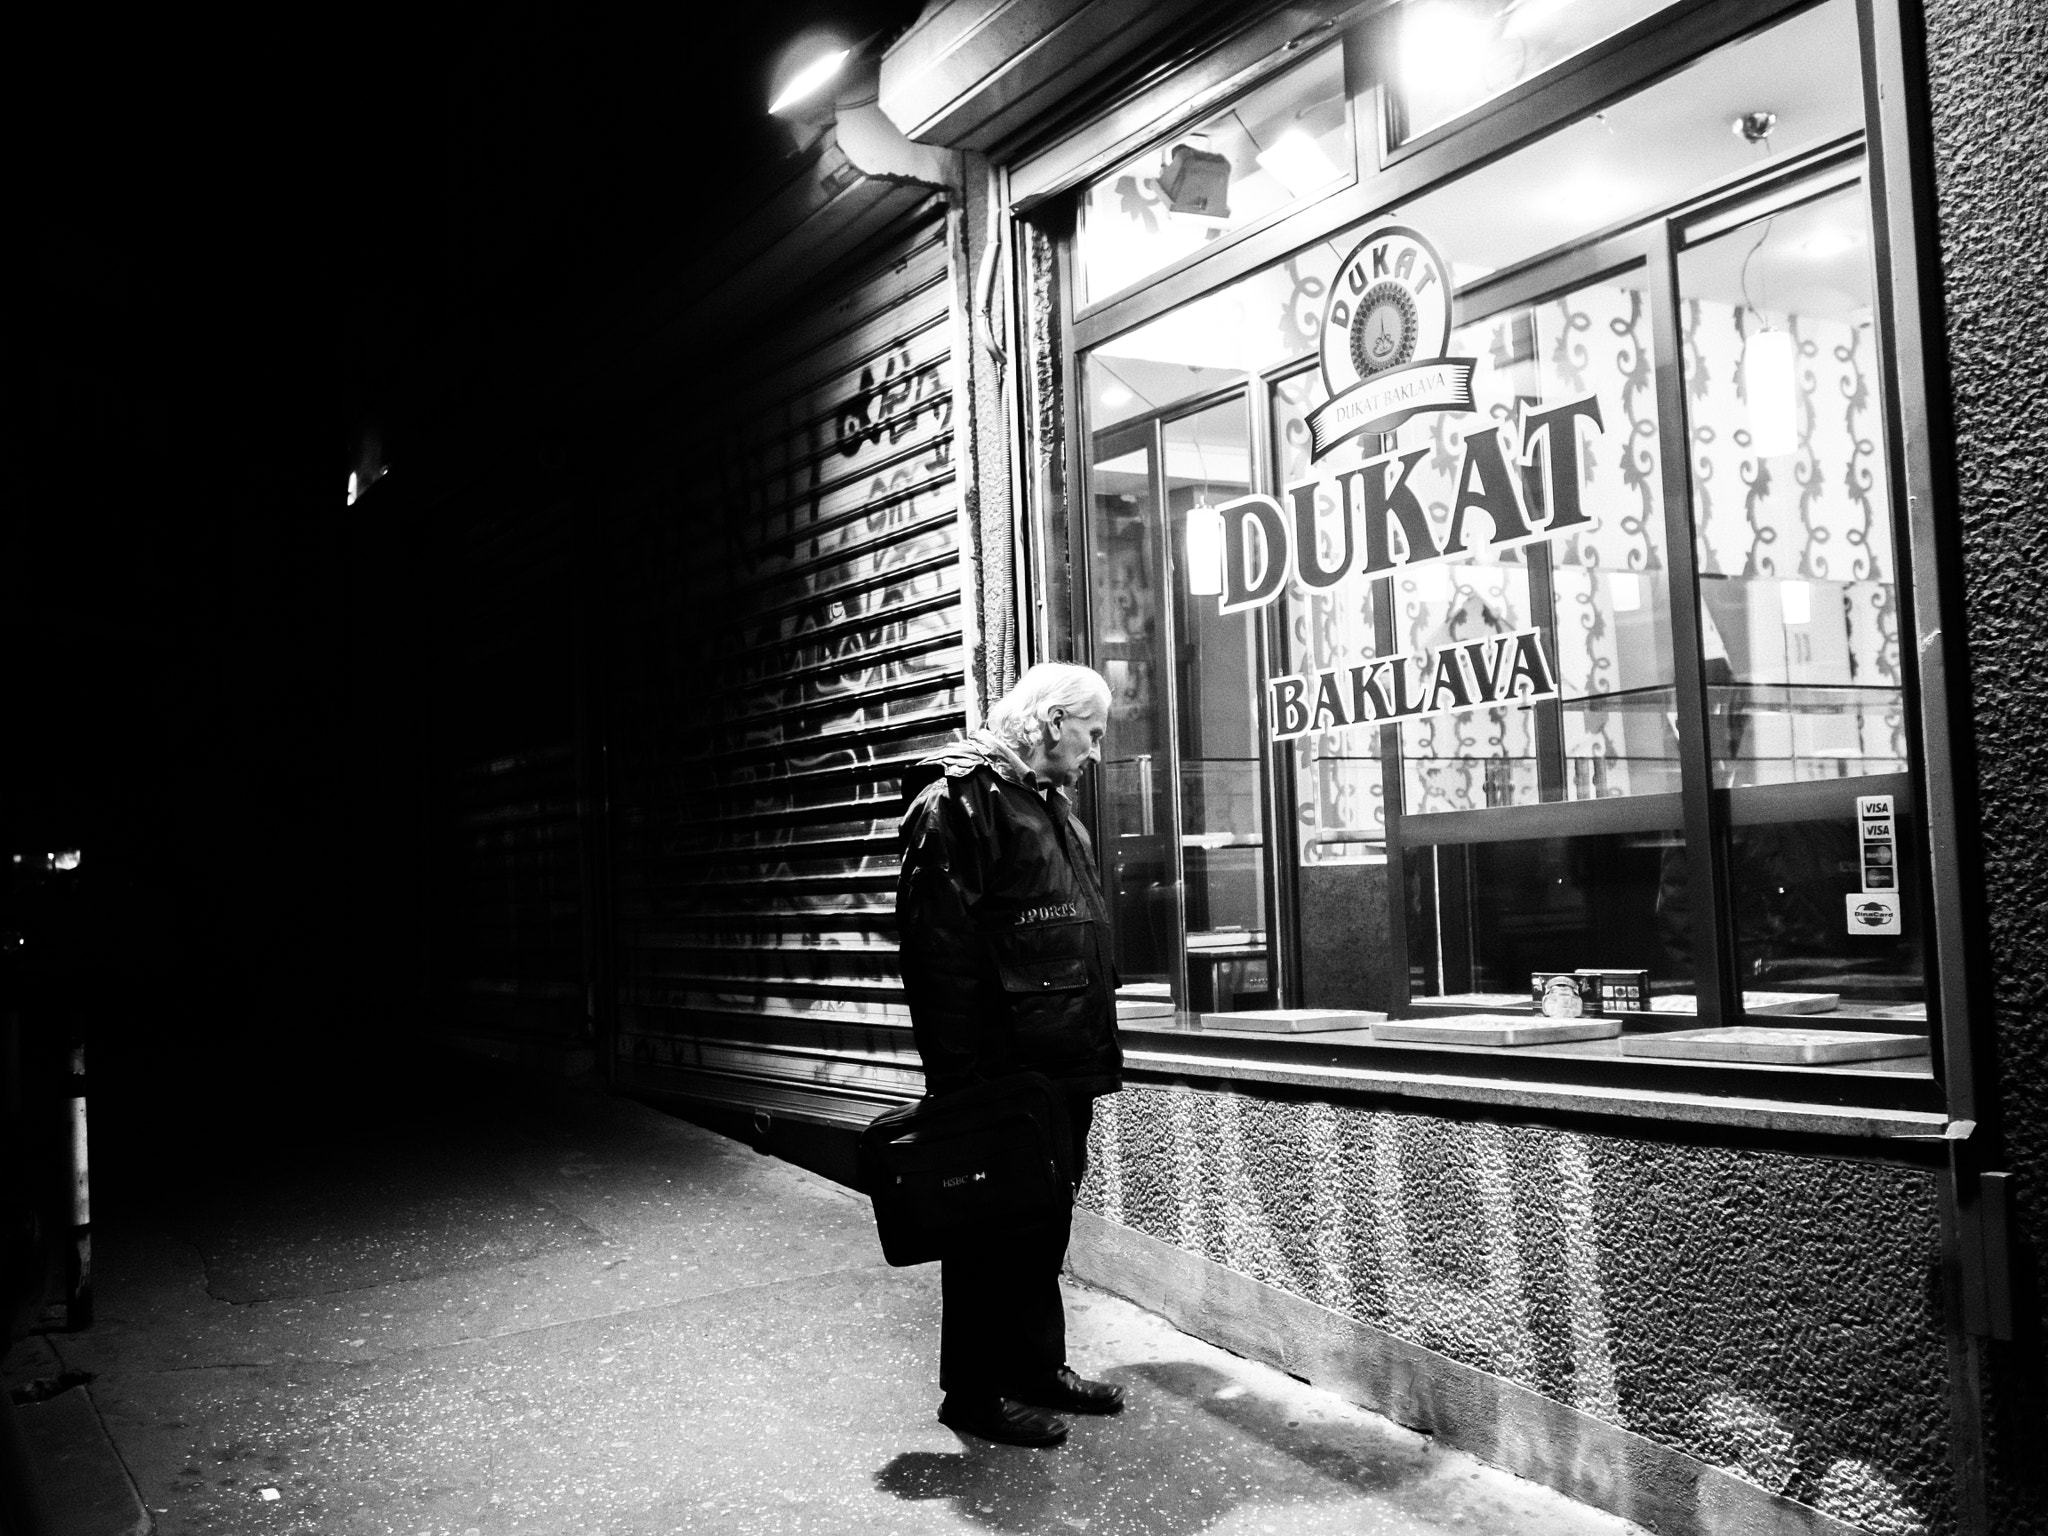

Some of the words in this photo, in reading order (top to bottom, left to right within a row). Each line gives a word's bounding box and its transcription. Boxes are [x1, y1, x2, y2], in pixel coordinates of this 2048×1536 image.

[1331, 244, 1437, 329] DUKAT
[1336, 393, 1381, 423] DUKAT
[1383, 373, 1446, 407] BAKLAVA
[1219, 394, 1605, 607] DUKAT
[1272, 633, 1554, 735] BAKLAVA
[1865, 803, 1888, 813] VISA
[1867, 825, 1889, 835] VISA
[1014, 902, 1077, 926] SPORTS
[943, 1175, 969, 1188] HSBC
